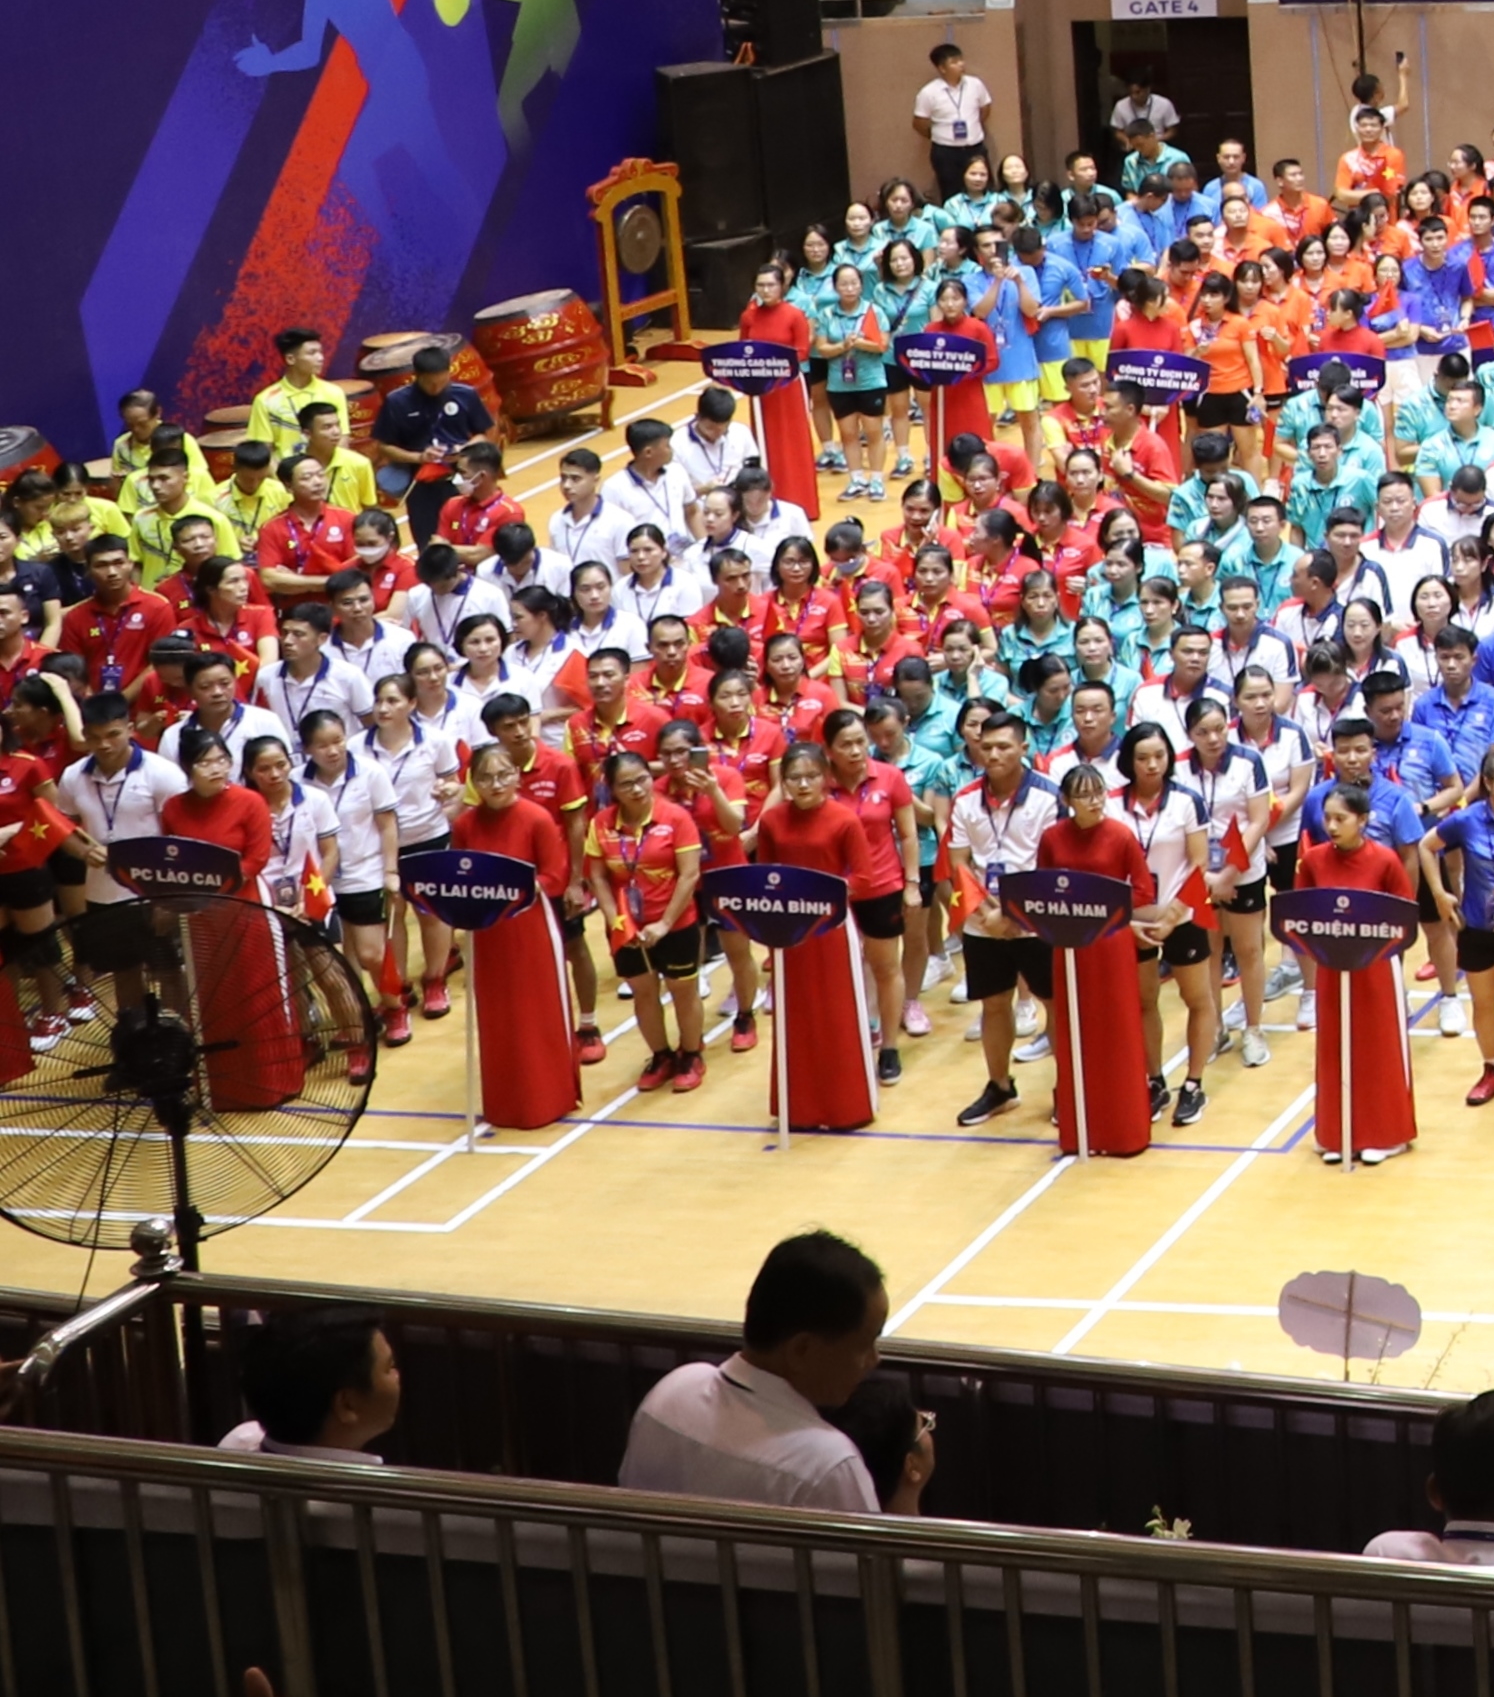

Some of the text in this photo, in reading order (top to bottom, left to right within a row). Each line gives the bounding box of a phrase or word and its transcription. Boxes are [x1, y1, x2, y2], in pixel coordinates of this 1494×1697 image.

[1129, 0, 1199, 15] GATE 4
[130, 867, 222, 886] PC LÀO CAI
[414, 881, 520, 901] PC LAI CHÂU
[719, 897, 832, 916] PC HÒA BÌNH
[1024, 899, 1108, 918] PC HÀ NAM
[1284, 919, 1403, 939] PC ĐIỆN BIÊN
